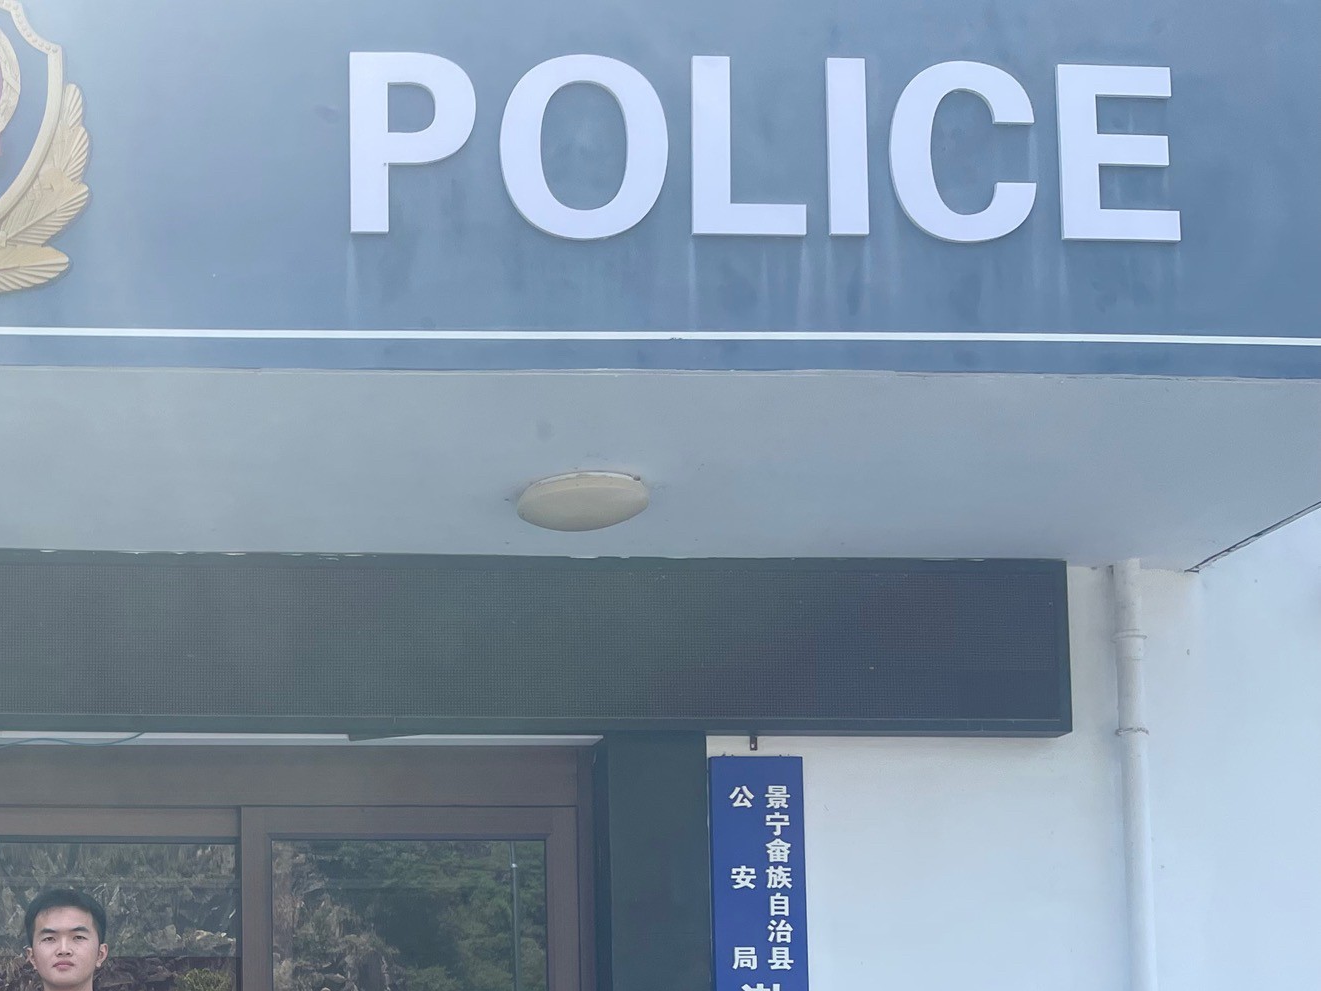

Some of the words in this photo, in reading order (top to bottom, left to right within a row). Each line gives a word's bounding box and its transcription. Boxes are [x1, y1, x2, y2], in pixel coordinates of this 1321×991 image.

[349, 51, 1182, 243] POLICE
[729, 785, 758, 970] 公安局
[764, 785, 794, 970] 景宁畲族自治县
